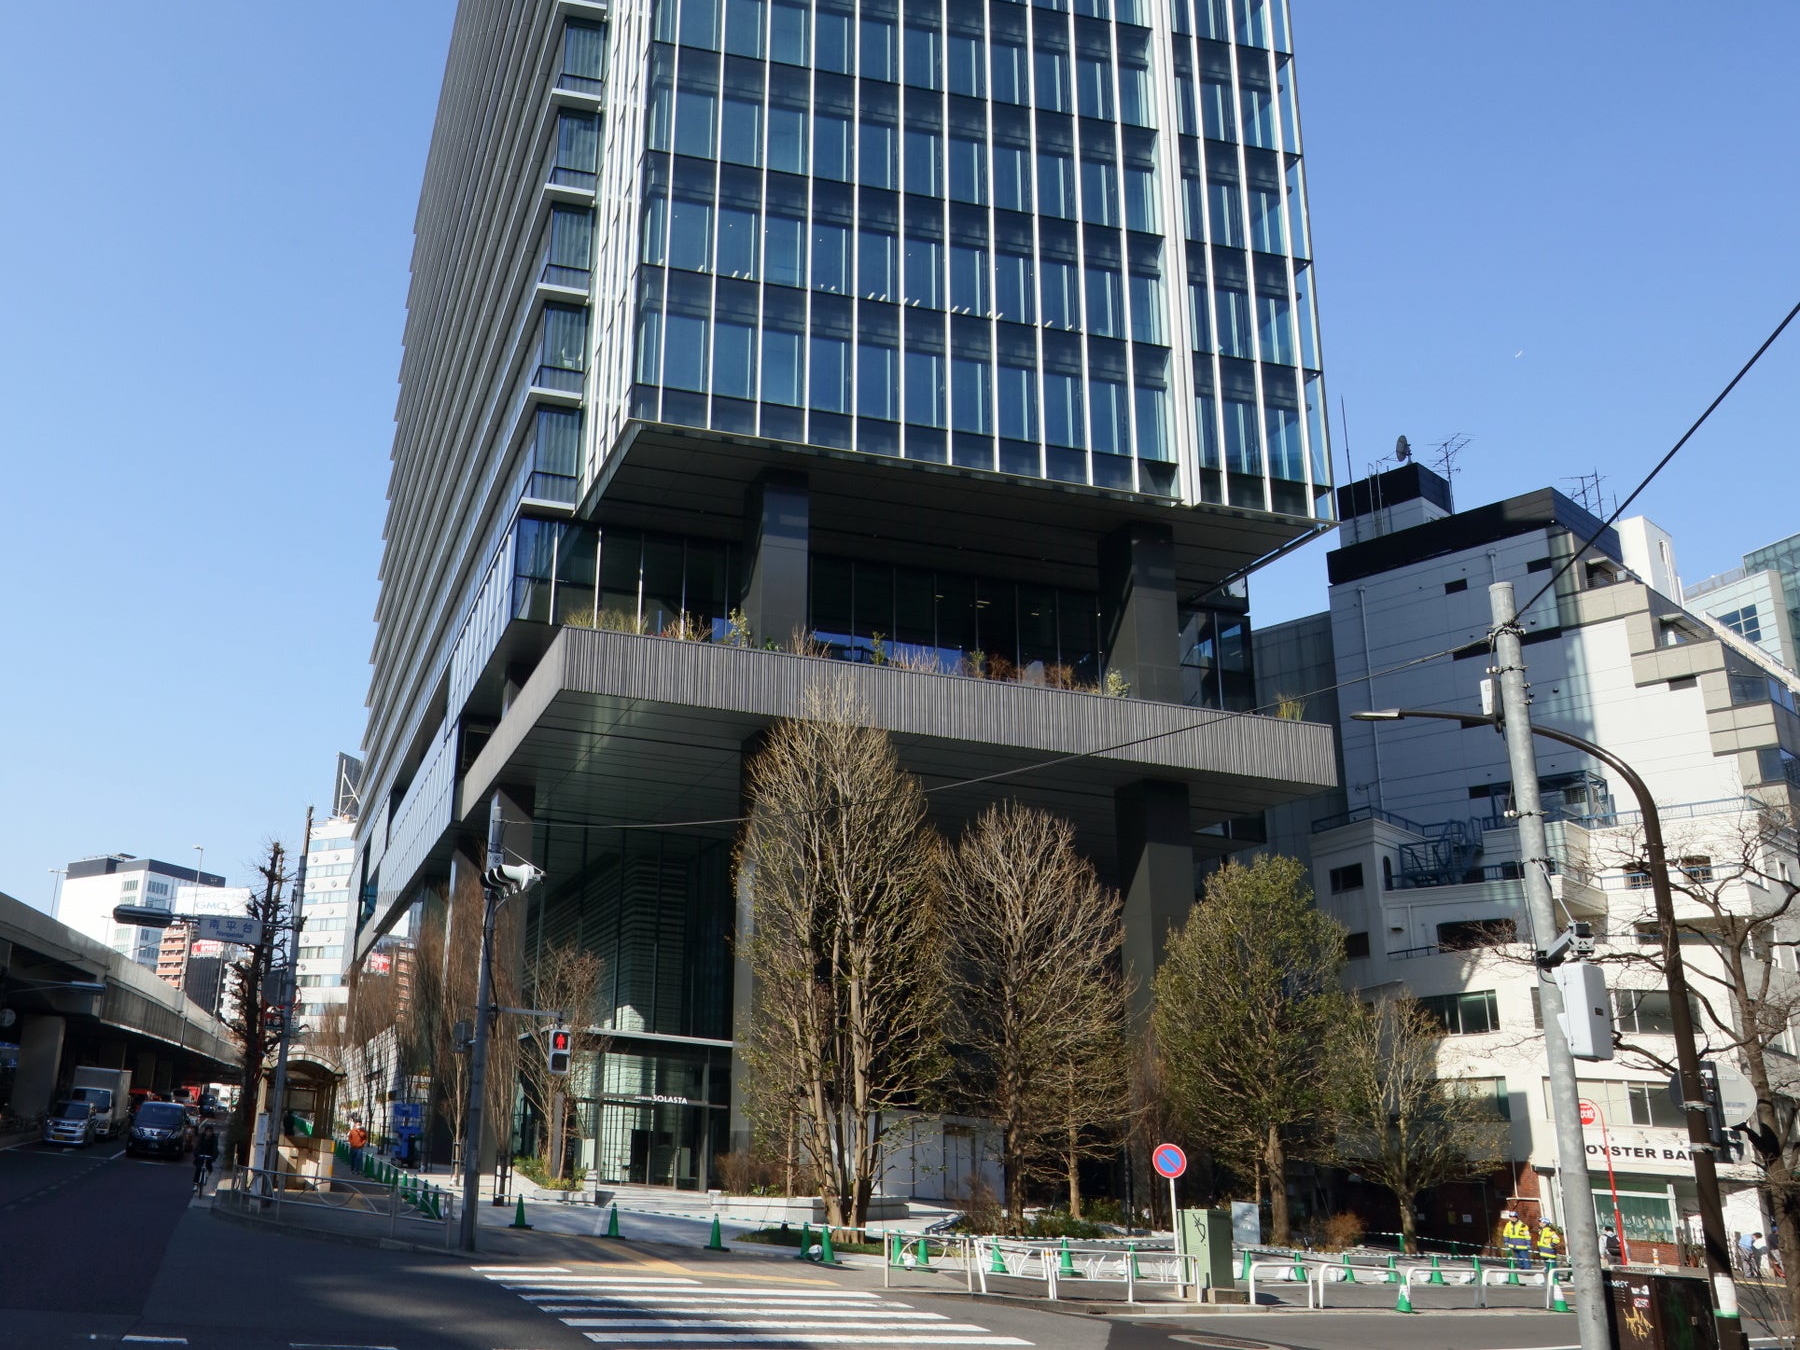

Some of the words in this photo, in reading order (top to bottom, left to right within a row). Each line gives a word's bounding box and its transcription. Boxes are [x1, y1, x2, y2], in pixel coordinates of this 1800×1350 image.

[195, 901, 228, 910] GMO
[209, 919, 254, 933] 南平台
[652, 1095, 688, 1105] SOLASTA
[1586, 1144, 1657, 1159] OYSTER
